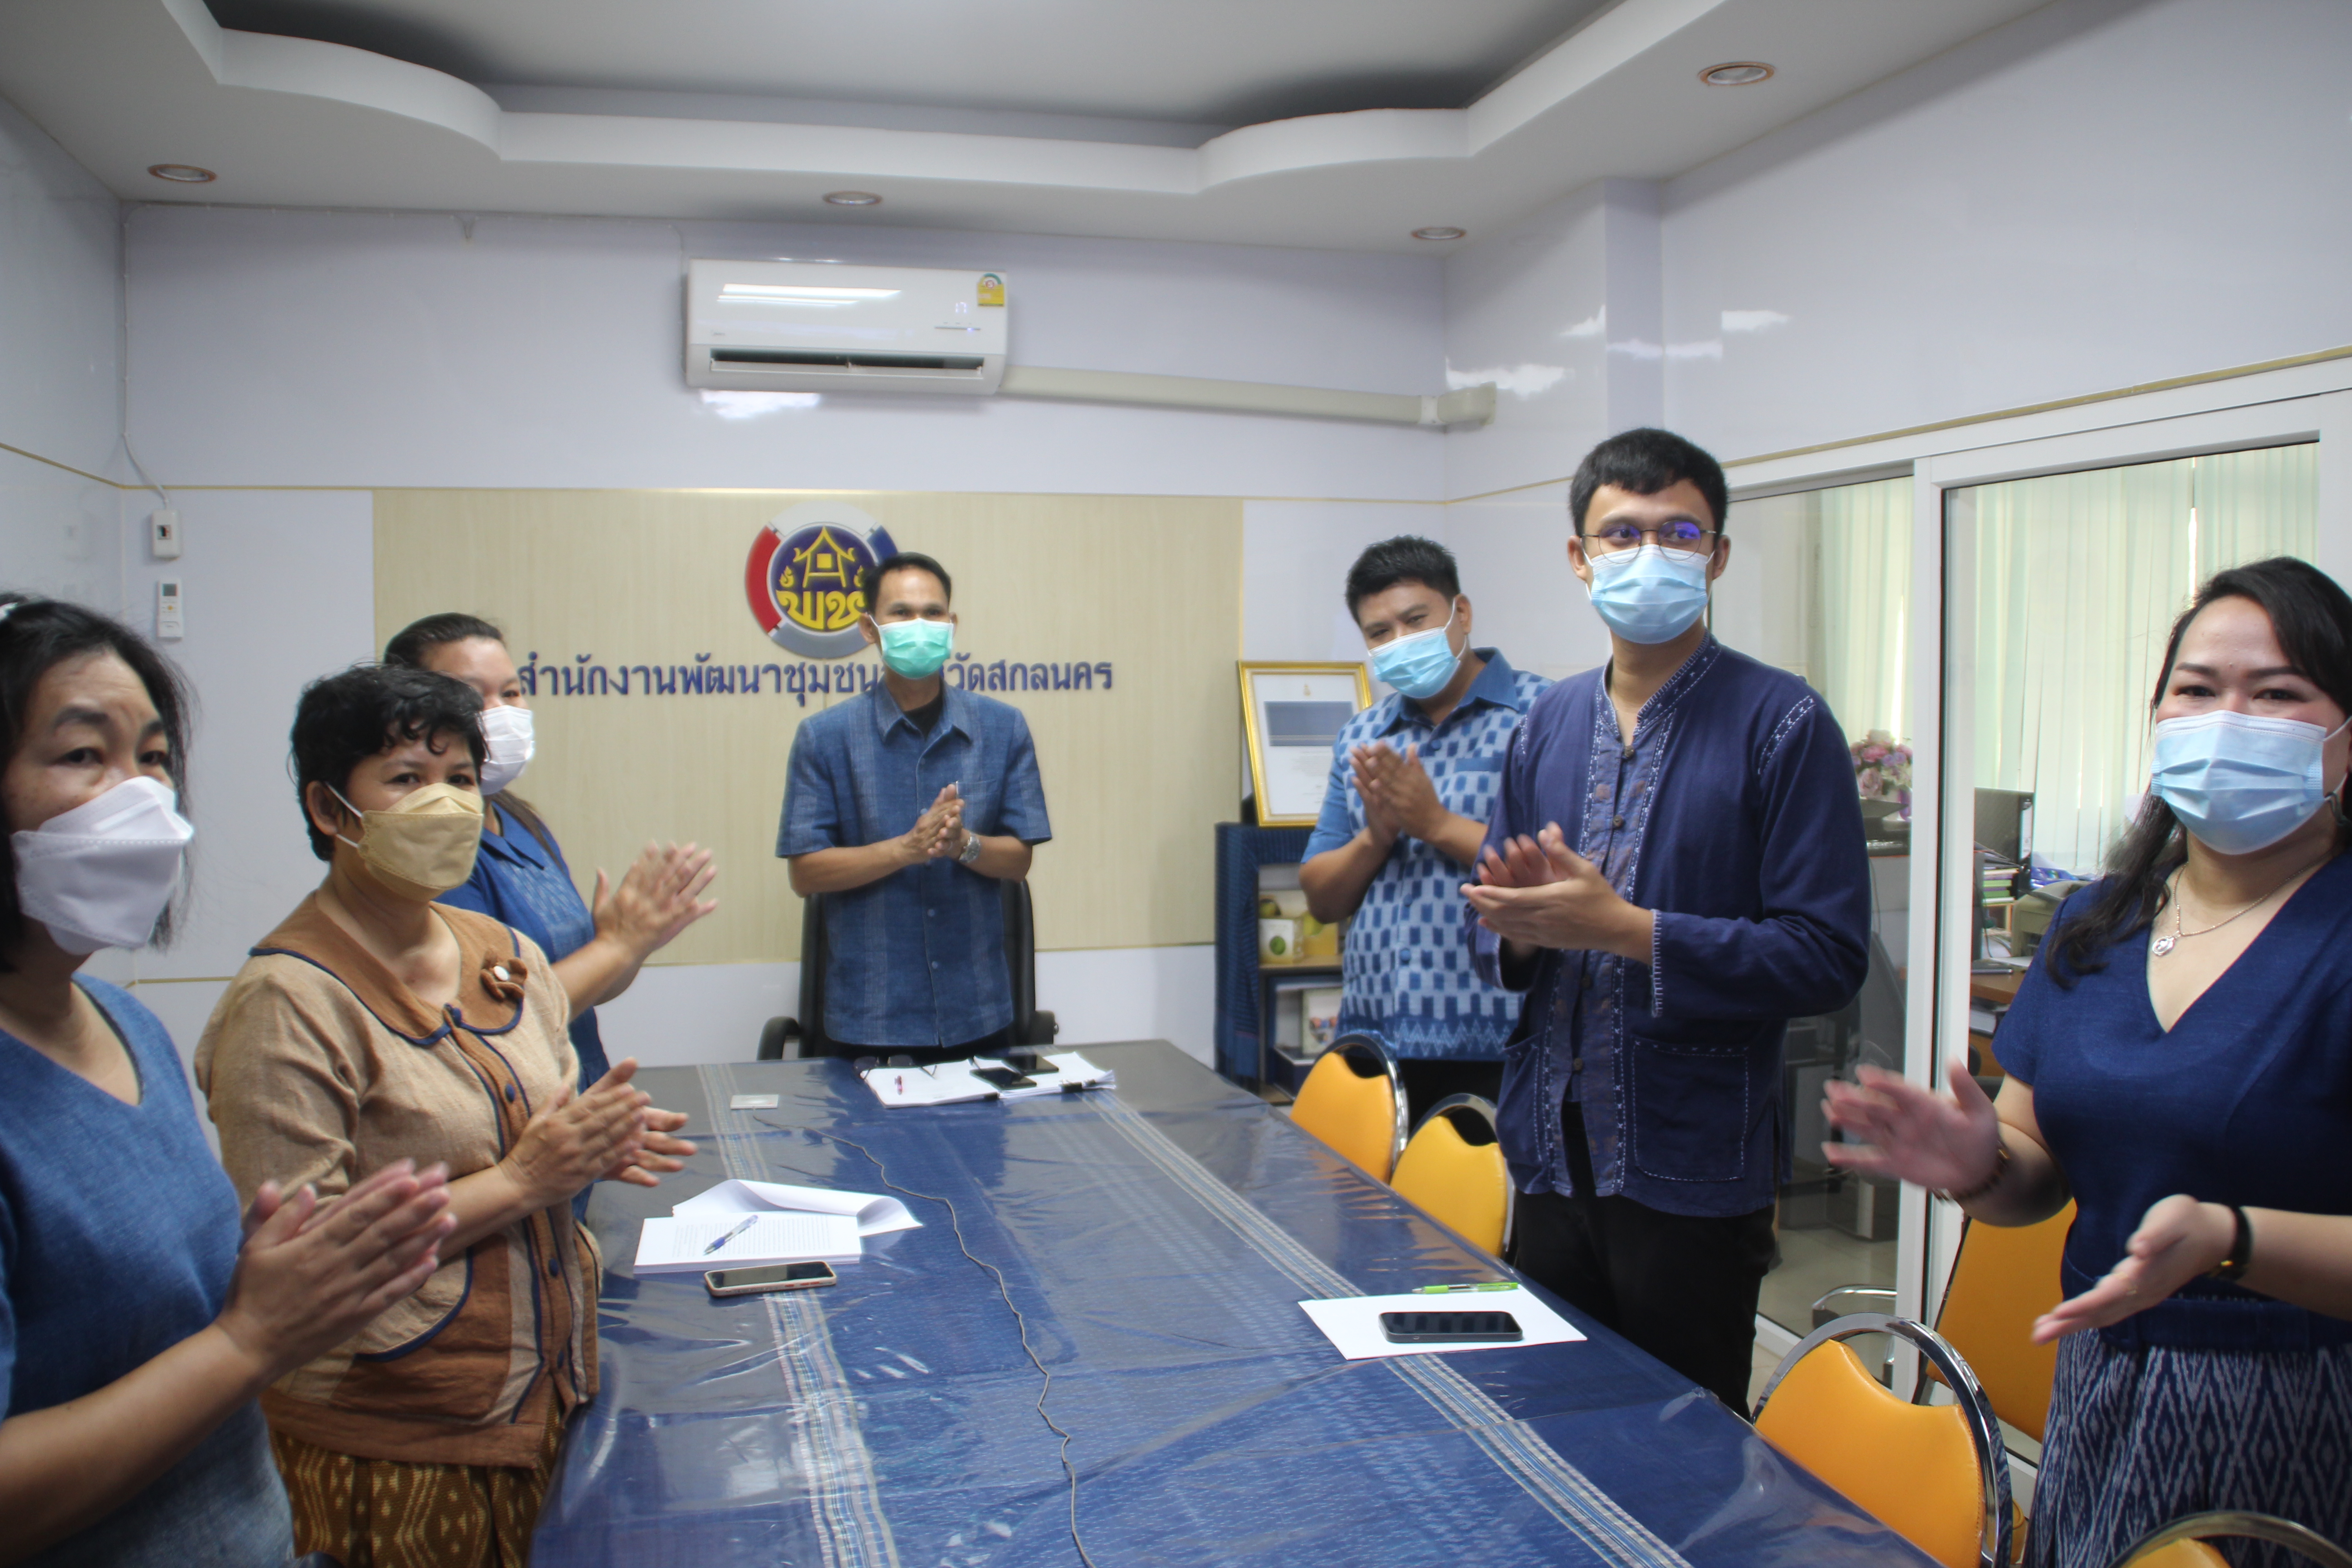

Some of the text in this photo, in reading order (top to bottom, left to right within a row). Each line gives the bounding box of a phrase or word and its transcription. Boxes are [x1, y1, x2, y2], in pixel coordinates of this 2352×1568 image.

[517, 651, 1112, 706] สำนักงานพัฒนาชุมชนวัดสกลนคร
